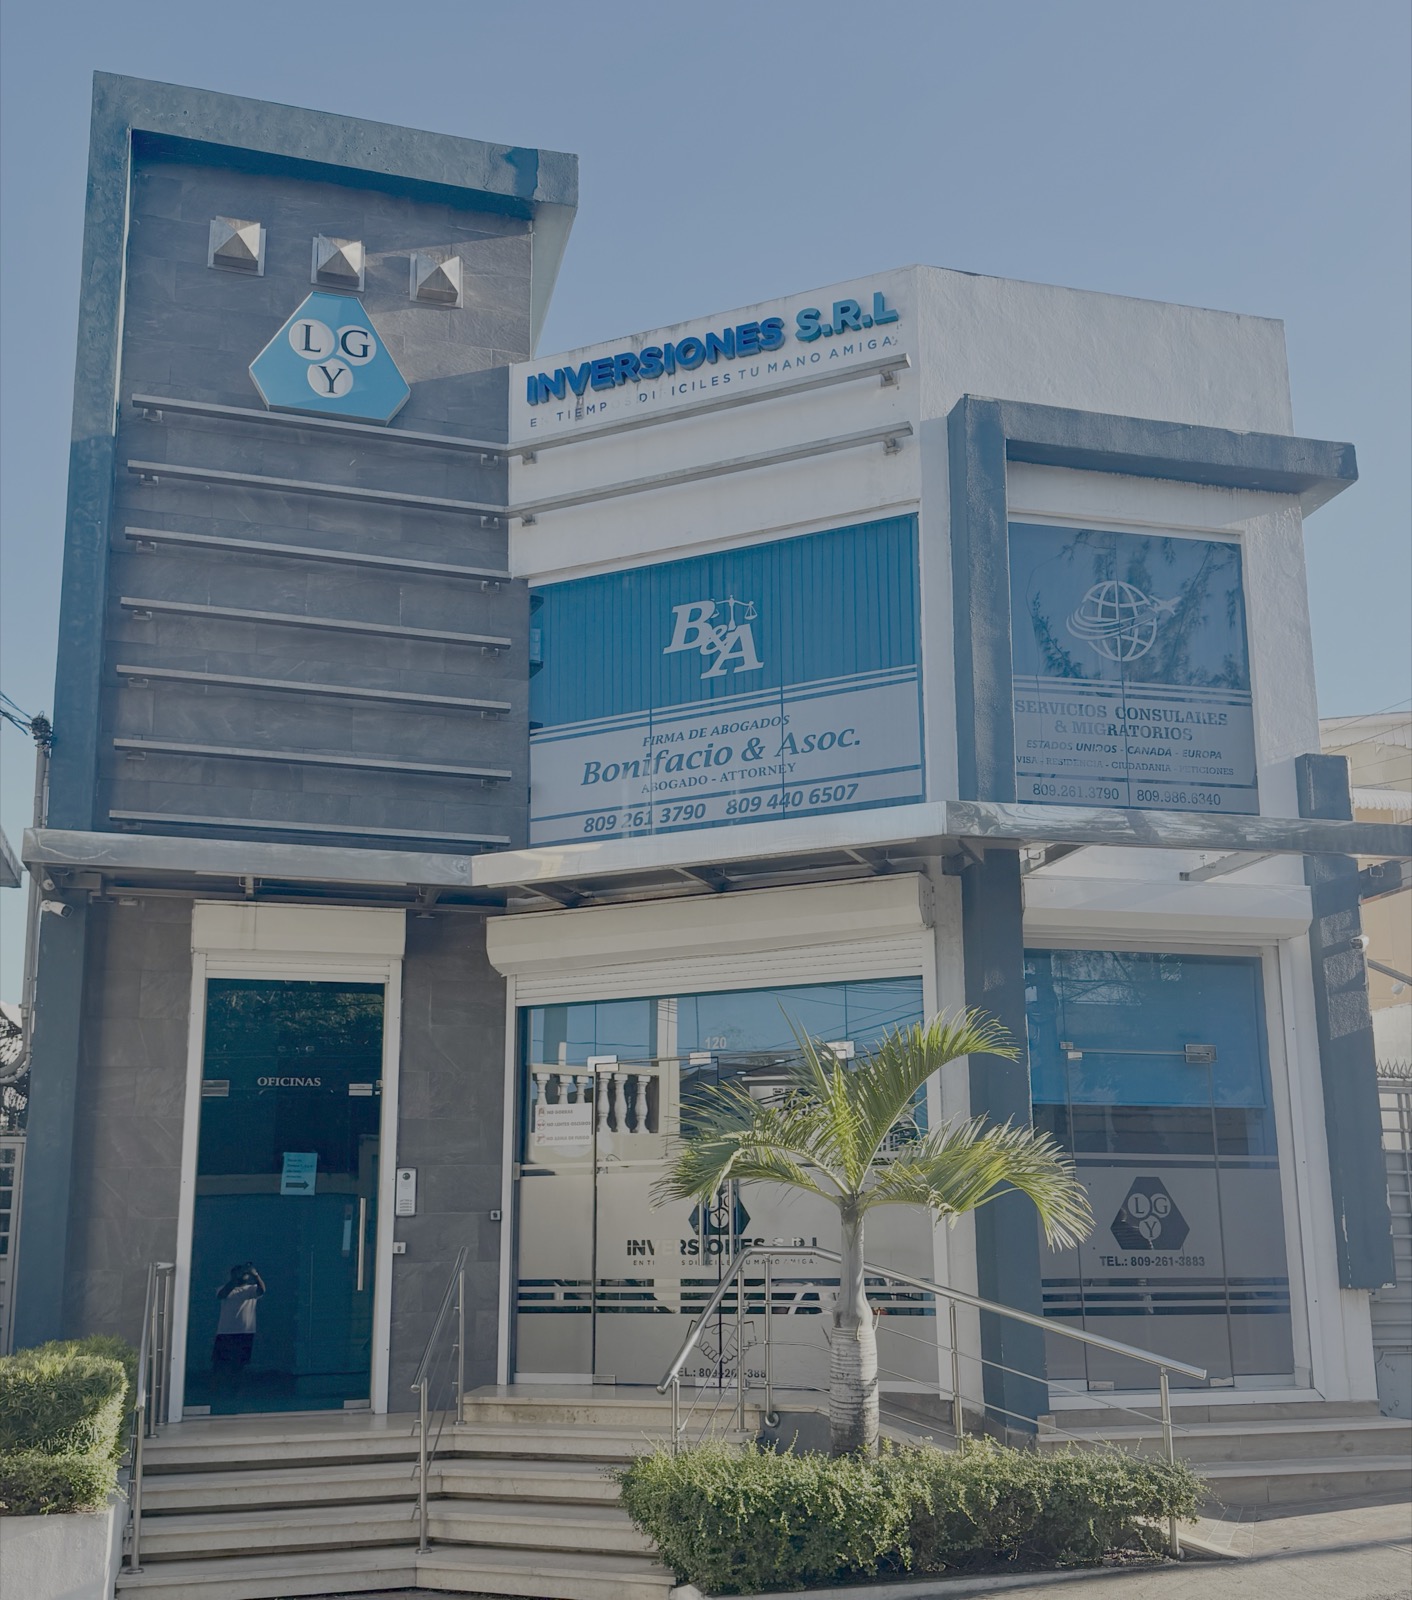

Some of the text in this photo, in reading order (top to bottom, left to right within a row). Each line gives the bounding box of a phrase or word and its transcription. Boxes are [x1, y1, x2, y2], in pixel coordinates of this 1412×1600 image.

[527, 292, 899, 406] INVERSIONES S.R.L
[639, 373, 732, 403] DIICILES
[738, 366, 760, 380] TU
[767, 352, 821, 374] MANO
[1015, 700, 1228, 726] SERVICIOS CONSULARES
[642, 714, 790, 747] FIRMA DE ABOGADOS
[1055, 720, 1193, 741] & MIGRATORIOS
[580, 727, 861, 786] Bonifacio & Asoc.
[1026, 739, 1073, 751] ESTADOS
[1076, 742, 1117, 754] UNIDOS
[1183, 749, 1222, 759] EUROPA
[1016, 755, 1038, 765] VISA
[1046, 757, 1103, 768] RESIDENCIA
[641, 774, 708, 795] ABOGADO
[720, 762, 796, 783] ATTORNEY
[1033, 783, 1119, 800] 809.261.3790
[583, 783, 859, 834] 809 261 3790 809 440 6507
[705, 1036, 727, 1050] 120
[257, 1077, 321, 1087] OFICINAS
[627, 1237, 765, 1256] INVERSONES
[1099, 1256, 1205, 1267] TEL.: 809-261-3883
[677, 1367, 696, 1377] EL.:
